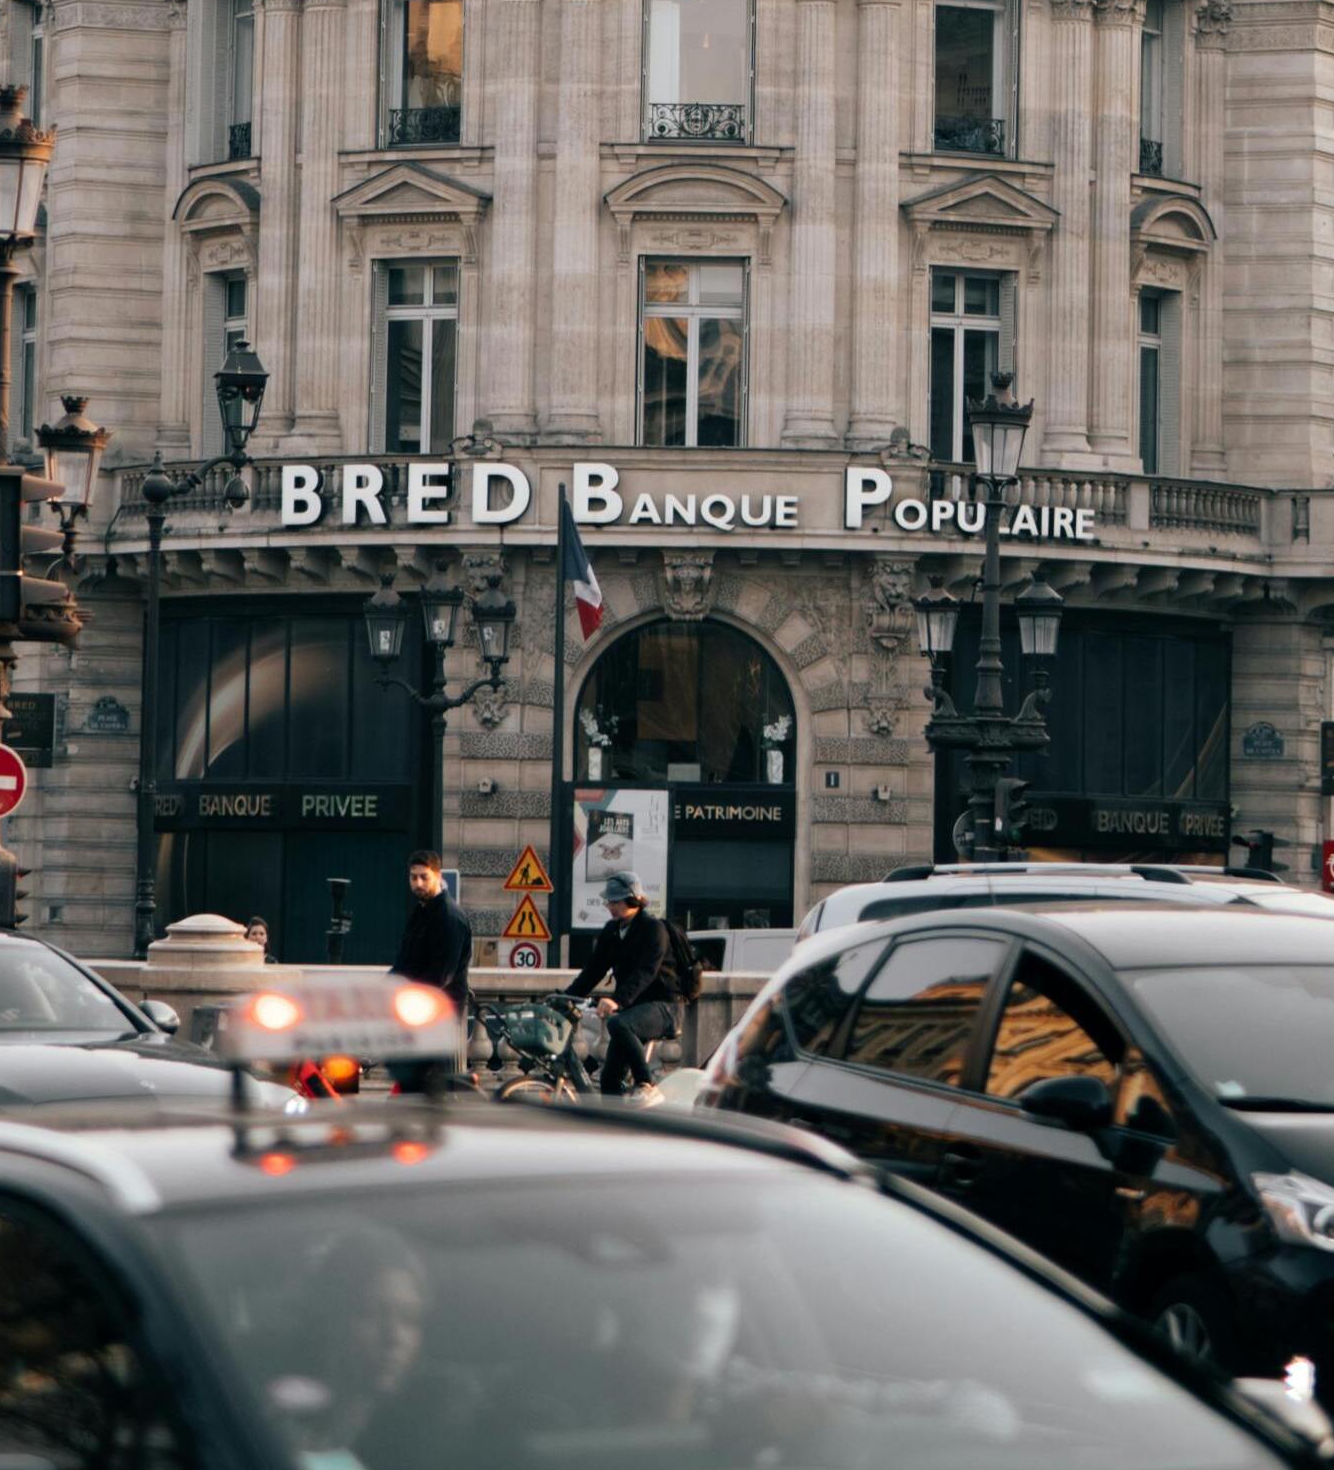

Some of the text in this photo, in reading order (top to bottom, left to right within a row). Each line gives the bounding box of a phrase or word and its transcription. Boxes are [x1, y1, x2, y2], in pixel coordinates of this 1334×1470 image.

[281, 462, 530, 526] BRED
[573, 462, 799, 531] BANQUE
[154, 793, 378, 817] RED BANQUE PRIVEE
[685, 805, 782, 820] PATRIMOINE
[1098, 810, 1170, 835] BANQUE
[516, 951, 537, 968] 30
